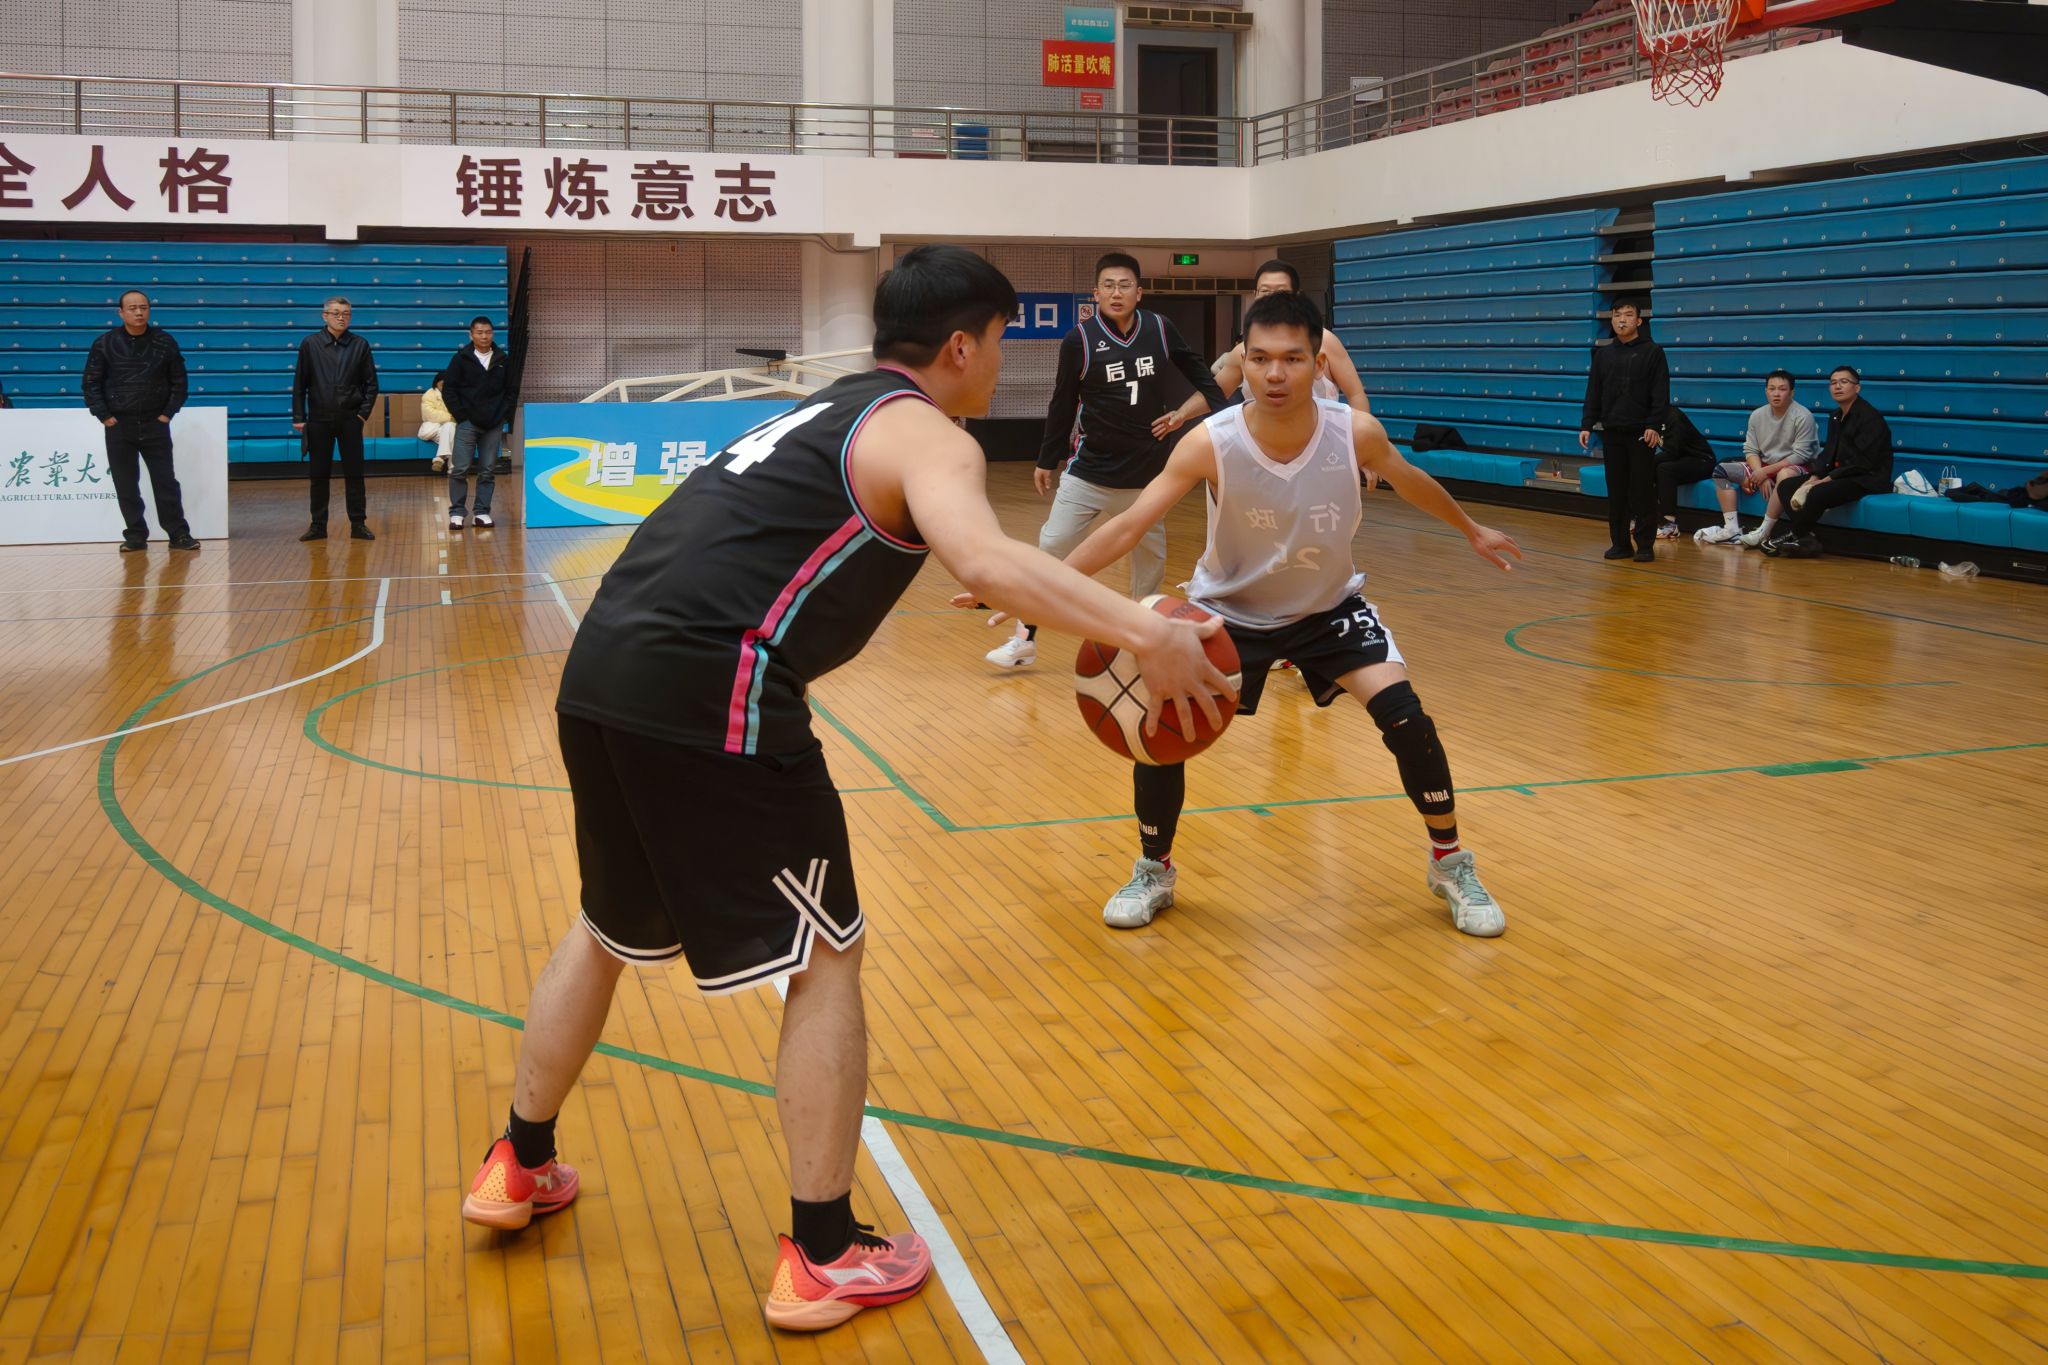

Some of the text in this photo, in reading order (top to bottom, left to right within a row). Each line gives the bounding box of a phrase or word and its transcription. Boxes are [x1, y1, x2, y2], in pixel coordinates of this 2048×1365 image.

[456, 154, 777, 222] 锤炼意志
[1105, 355, 1155, 383] 后保
[1125, 380, 1139, 406] 7
[1, 493, 74, 502] AGRICULTURAL
[1431, 789, 1450, 802] NBA
[1142, 823, 1158, 836] NBA
